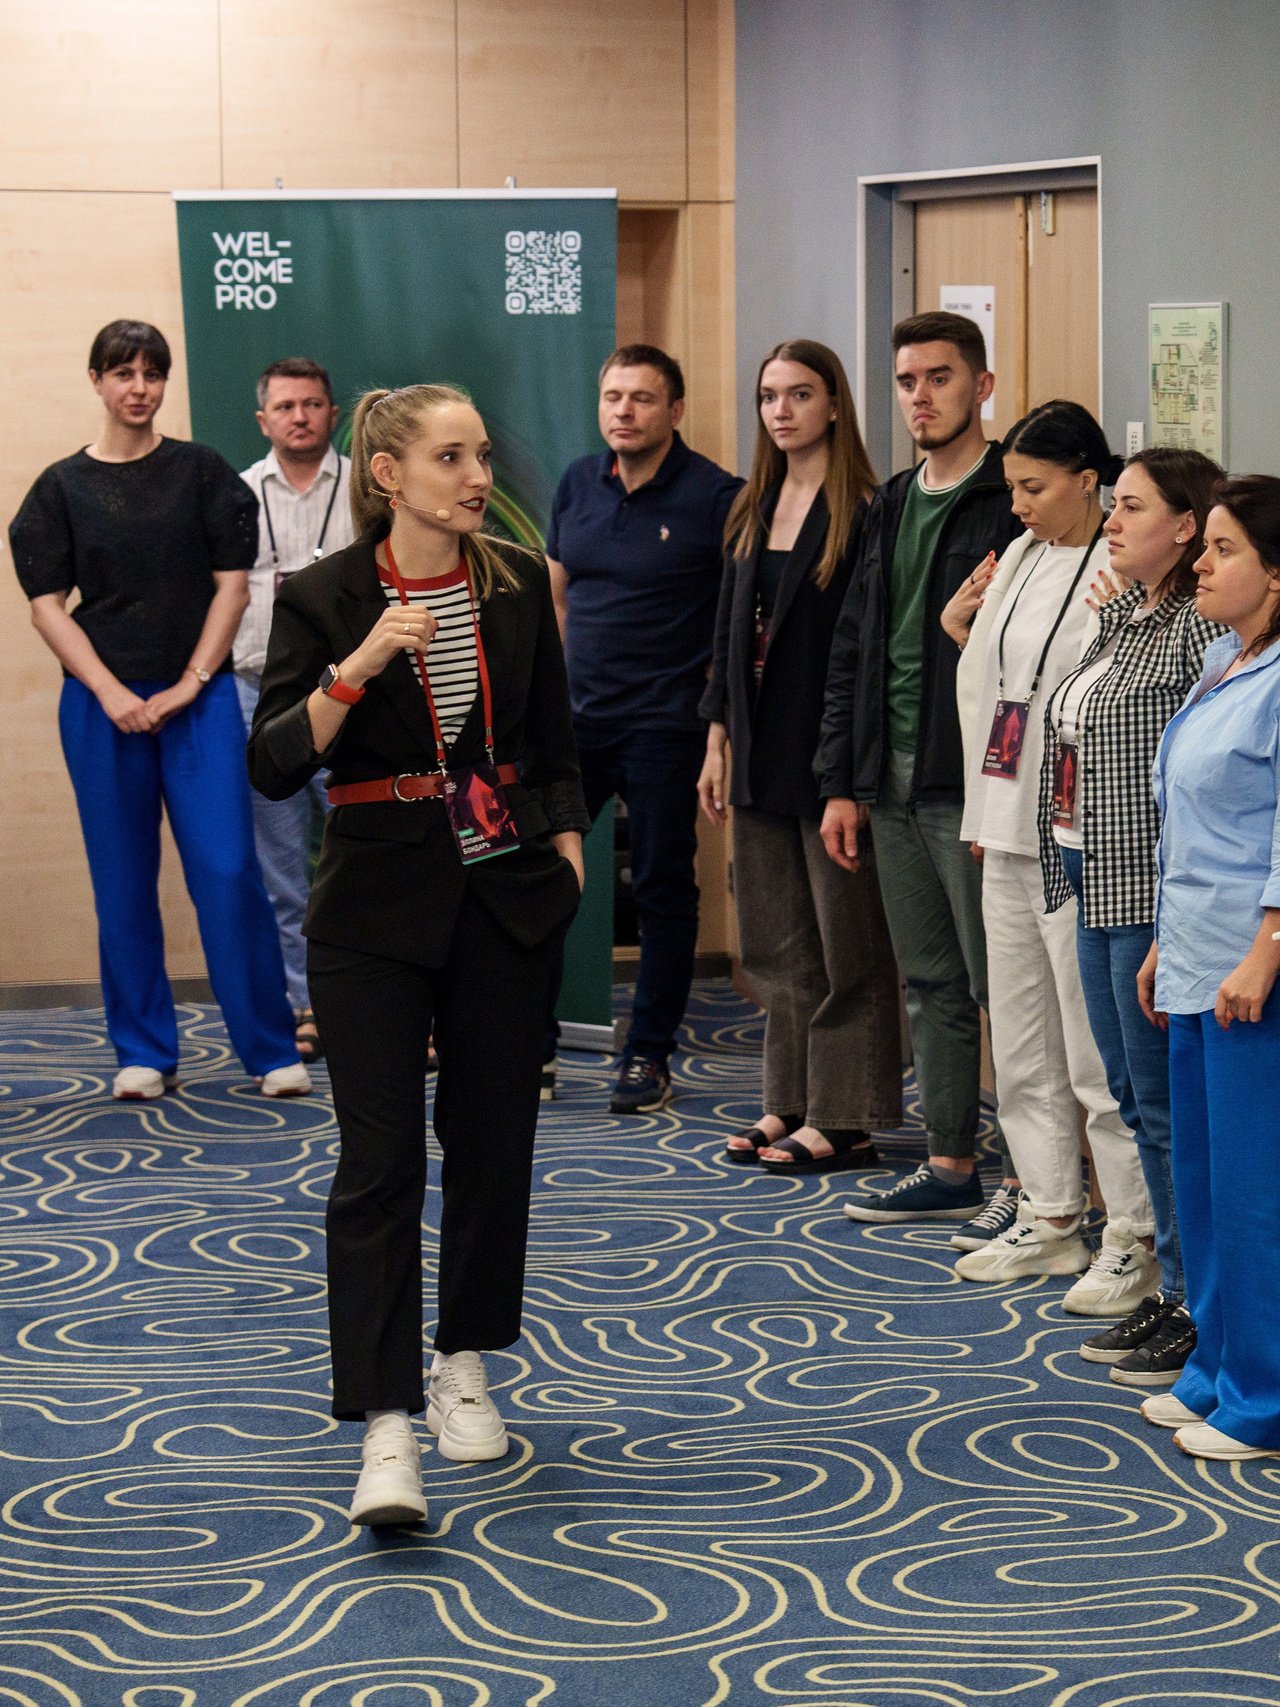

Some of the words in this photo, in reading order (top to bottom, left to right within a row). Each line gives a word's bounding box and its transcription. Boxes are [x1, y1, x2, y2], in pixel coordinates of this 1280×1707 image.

[212, 231, 291, 257] WEL-
[214, 258, 293, 283] COME
[215, 284, 277, 310] PRO
